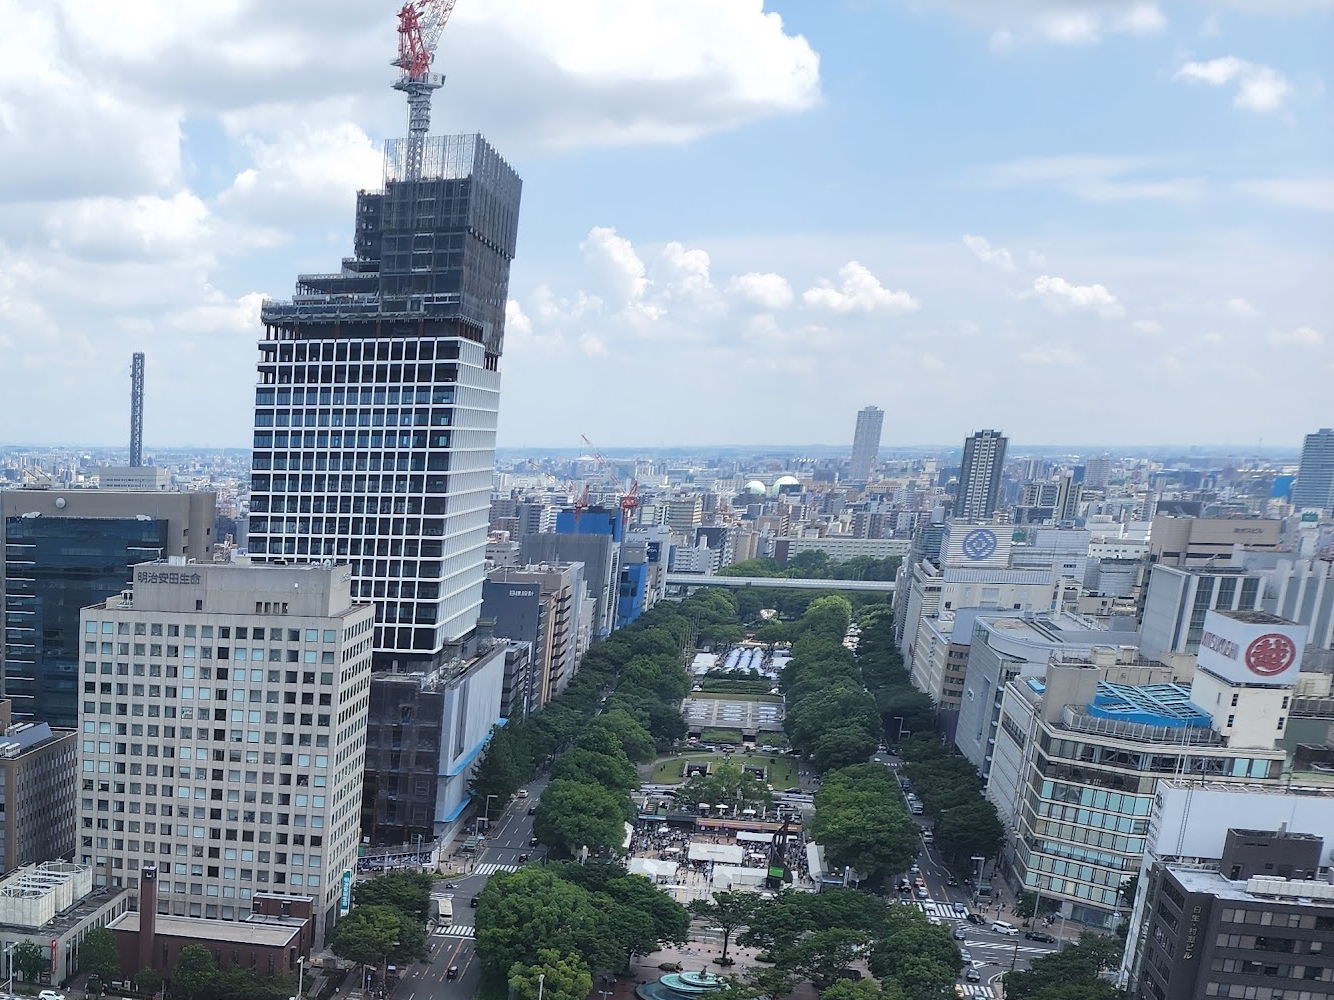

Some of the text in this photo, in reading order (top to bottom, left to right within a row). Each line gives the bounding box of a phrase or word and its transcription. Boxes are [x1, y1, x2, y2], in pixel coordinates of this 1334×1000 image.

[137, 572, 202, 586] 明治安田生命
